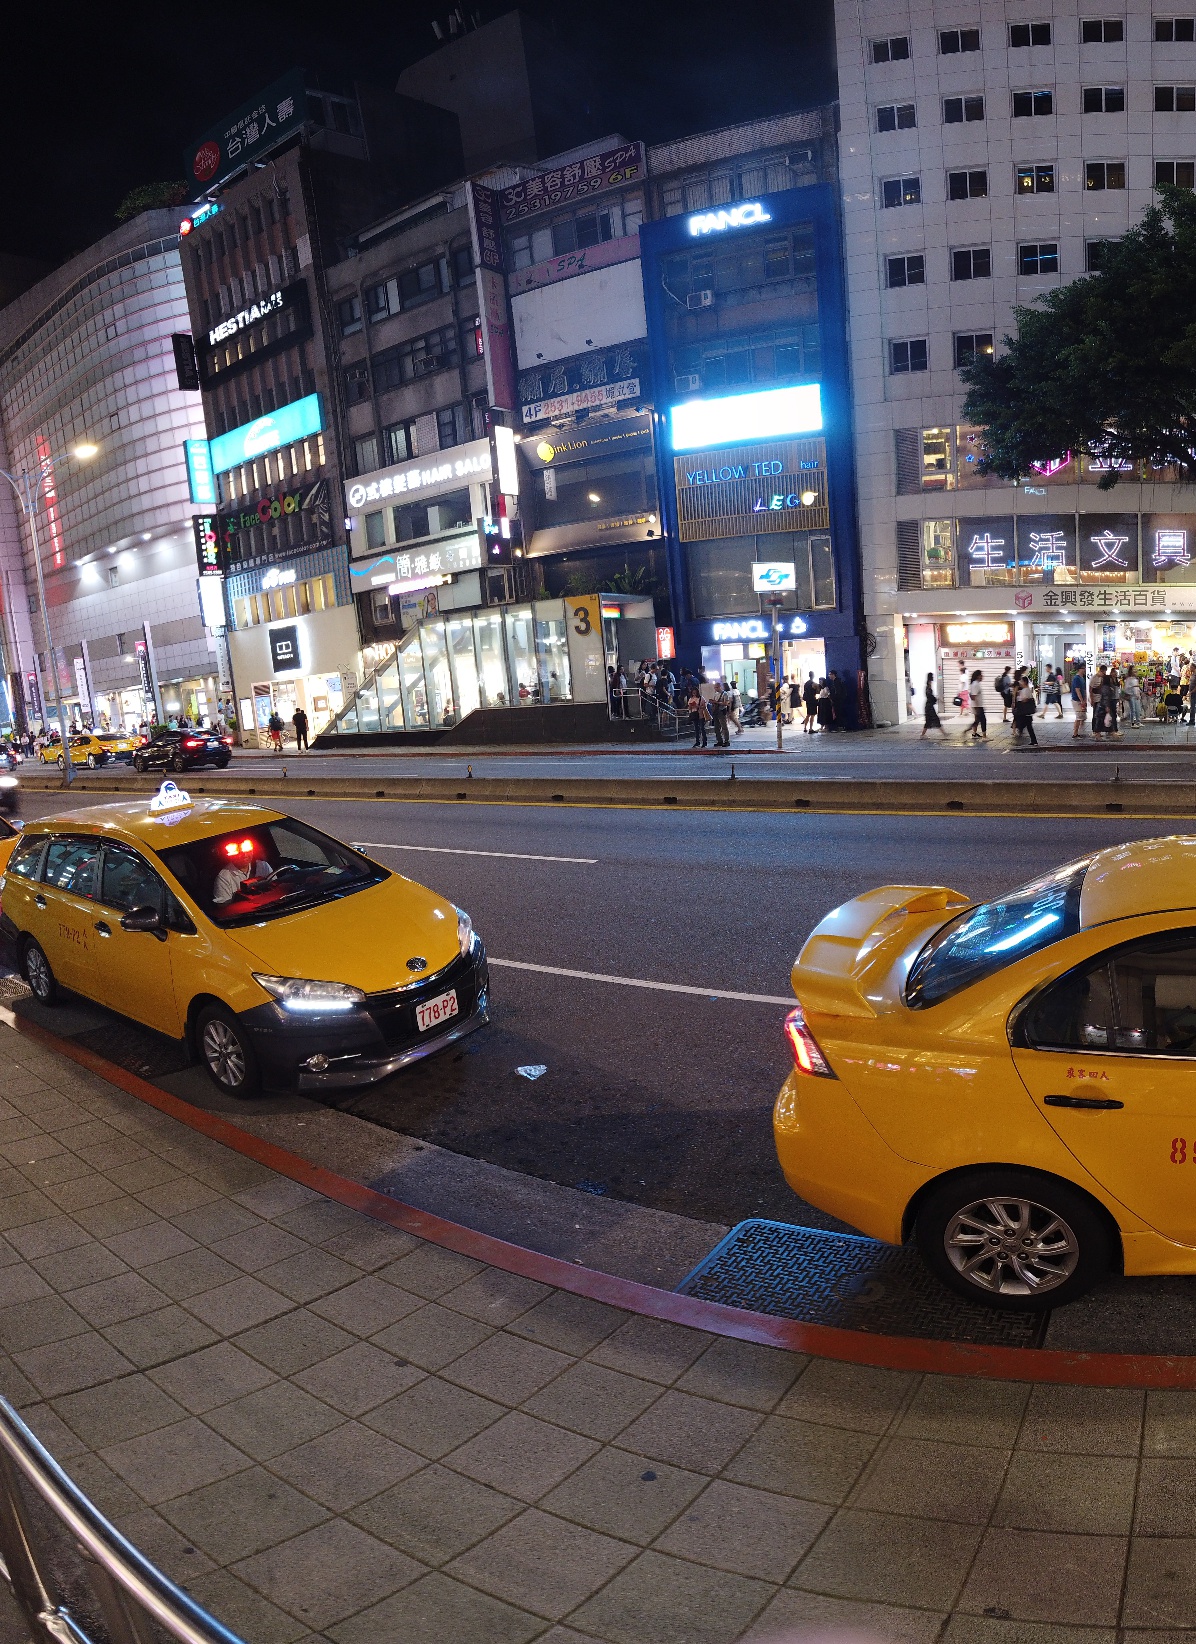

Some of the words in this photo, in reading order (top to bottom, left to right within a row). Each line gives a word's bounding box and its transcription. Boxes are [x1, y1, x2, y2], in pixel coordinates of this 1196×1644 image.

[227, 96, 295, 158] 台灣人壽
[506, 178, 602, 220] 25319759
[608, 166, 639, 184] 6F
[689, 203, 771, 236] FANCL
[209, 303, 262, 345] HESTIA
[524, 404, 543, 420] 4F
[421, 463, 453, 486] HAIR
[454, 453, 492, 477] SALO
[686, 465, 747, 486] YELLOW
[752, 460, 783, 477] TED
[800, 459, 819, 470] hair
[240, 512, 260, 529] Face
[257, 492, 301, 524] Color
[1042, 589, 1168, 608] 金興發生活百貨
[573, 606, 593, 637] 3
[713, 619, 769, 641] FANCL
[418, 995, 457, 1027] 778-P2
